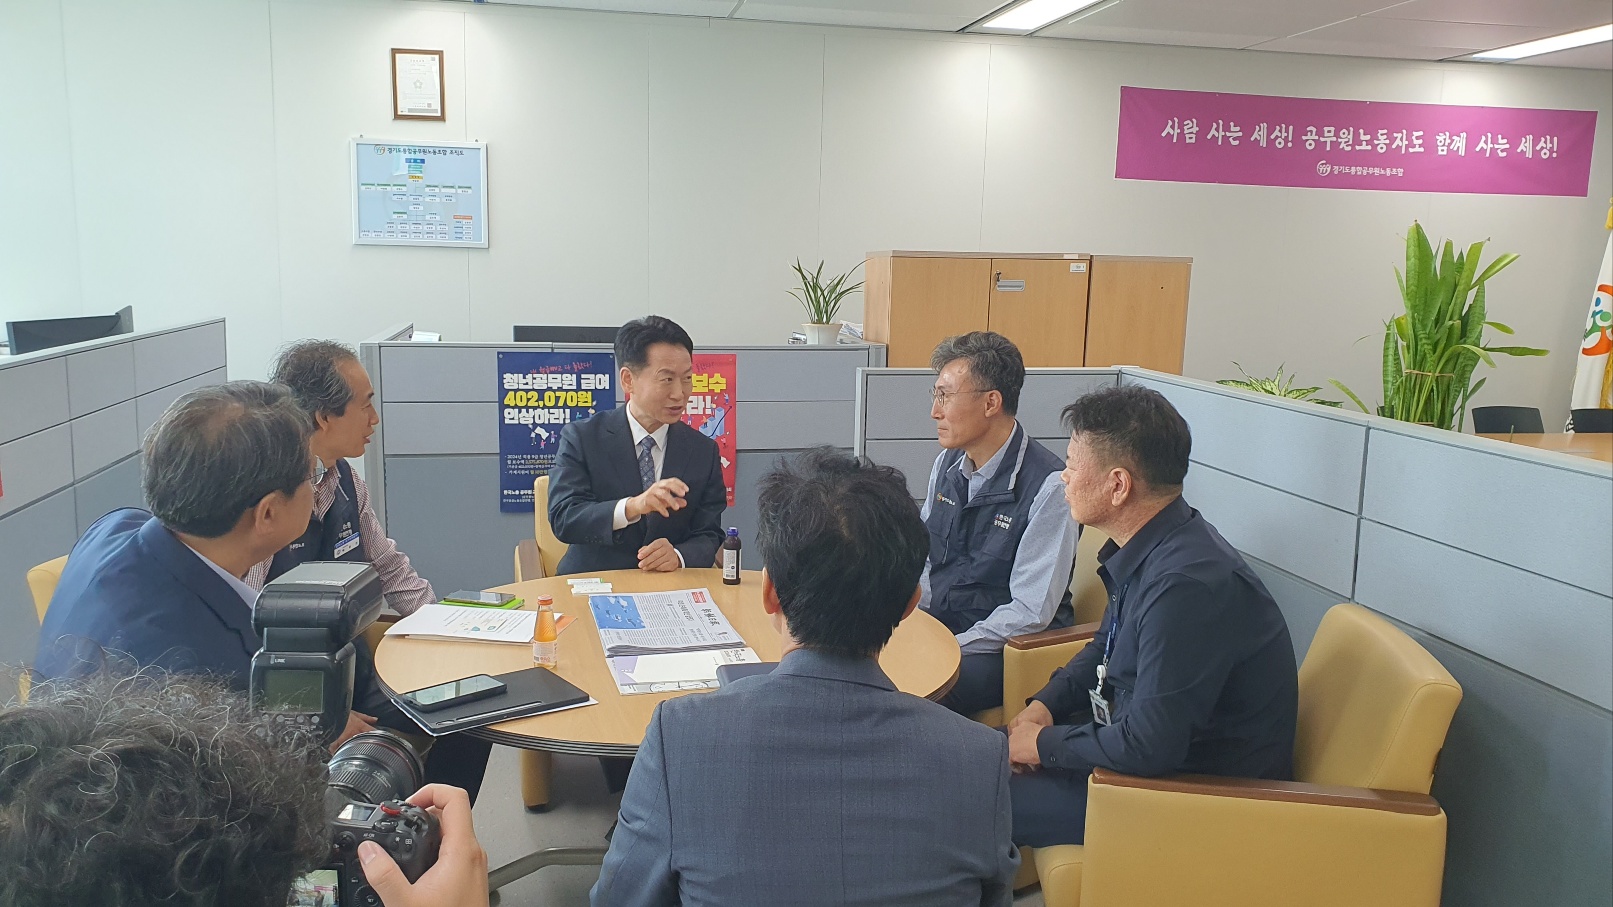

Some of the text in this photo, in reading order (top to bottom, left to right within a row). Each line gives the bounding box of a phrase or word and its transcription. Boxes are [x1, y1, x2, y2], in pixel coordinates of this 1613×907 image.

[1161, 117, 1558, 159] 사람 사는 세상! 공무원노동자도 함께 사는 세상!
[449, 149, 465, 157] 조직도
[1332, 165, 1404, 177] 경기도통합공무원노동조합
[502, 372, 610, 390] 청년공무원 급여
[691, 372, 727, 393] 보수
[503, 390, 593, 408] 402,070원
[682, 395, 712, 415] 라!
[503, 408, 571, 425] 인상하라!
